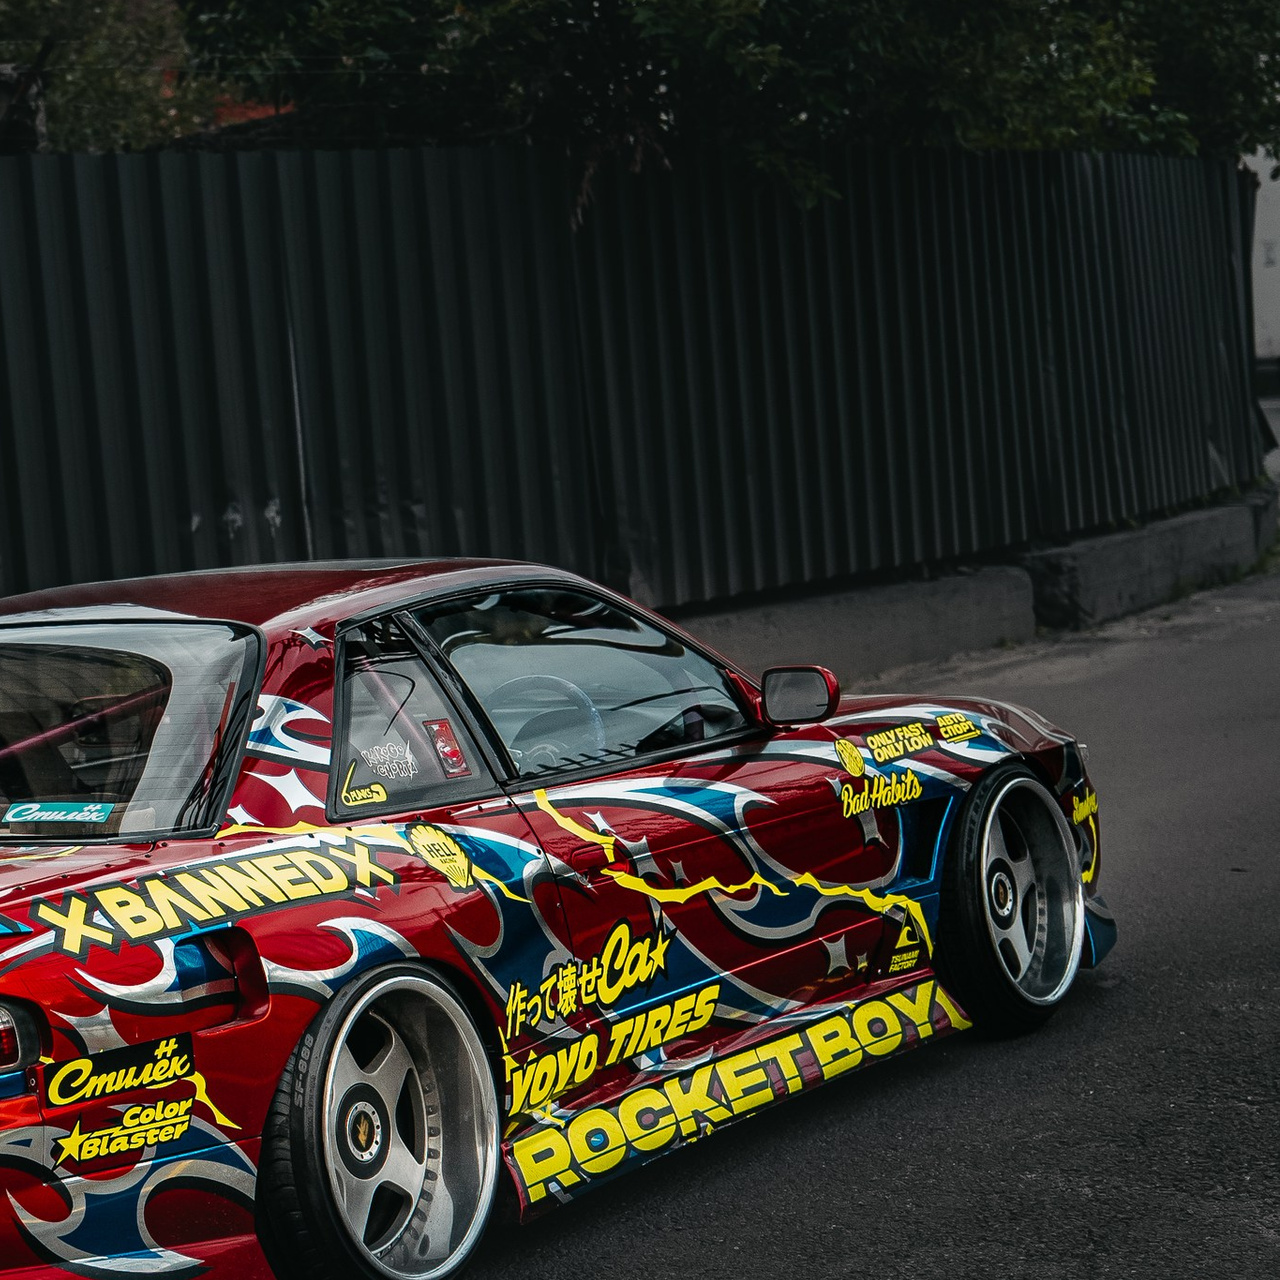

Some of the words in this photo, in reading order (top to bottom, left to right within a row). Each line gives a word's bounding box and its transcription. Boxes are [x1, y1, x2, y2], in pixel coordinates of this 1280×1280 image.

[936, 712, 966, 727] АВТО
[940, 721, 976, 739] СПОРТ
[866, 730, 896, 749] ONLY
[895, 722, 926, 740] FAST
[873, 741, 905, 762] ONLY
[904, 733, 934, 752] LOW
[841, 779, 870, 818] Bad
[870, 768, 923, 809] Habits
[422, 842, 457, 858] HELL
[508, 1033, 599, 1117] YOYO
[605, 984, 721, 1067] TIRES
[294, 1033, 314, 1108] SF-888
[122, 1098, 193, 1127] Color
[80, 1121, 189, 1160] Blaster
